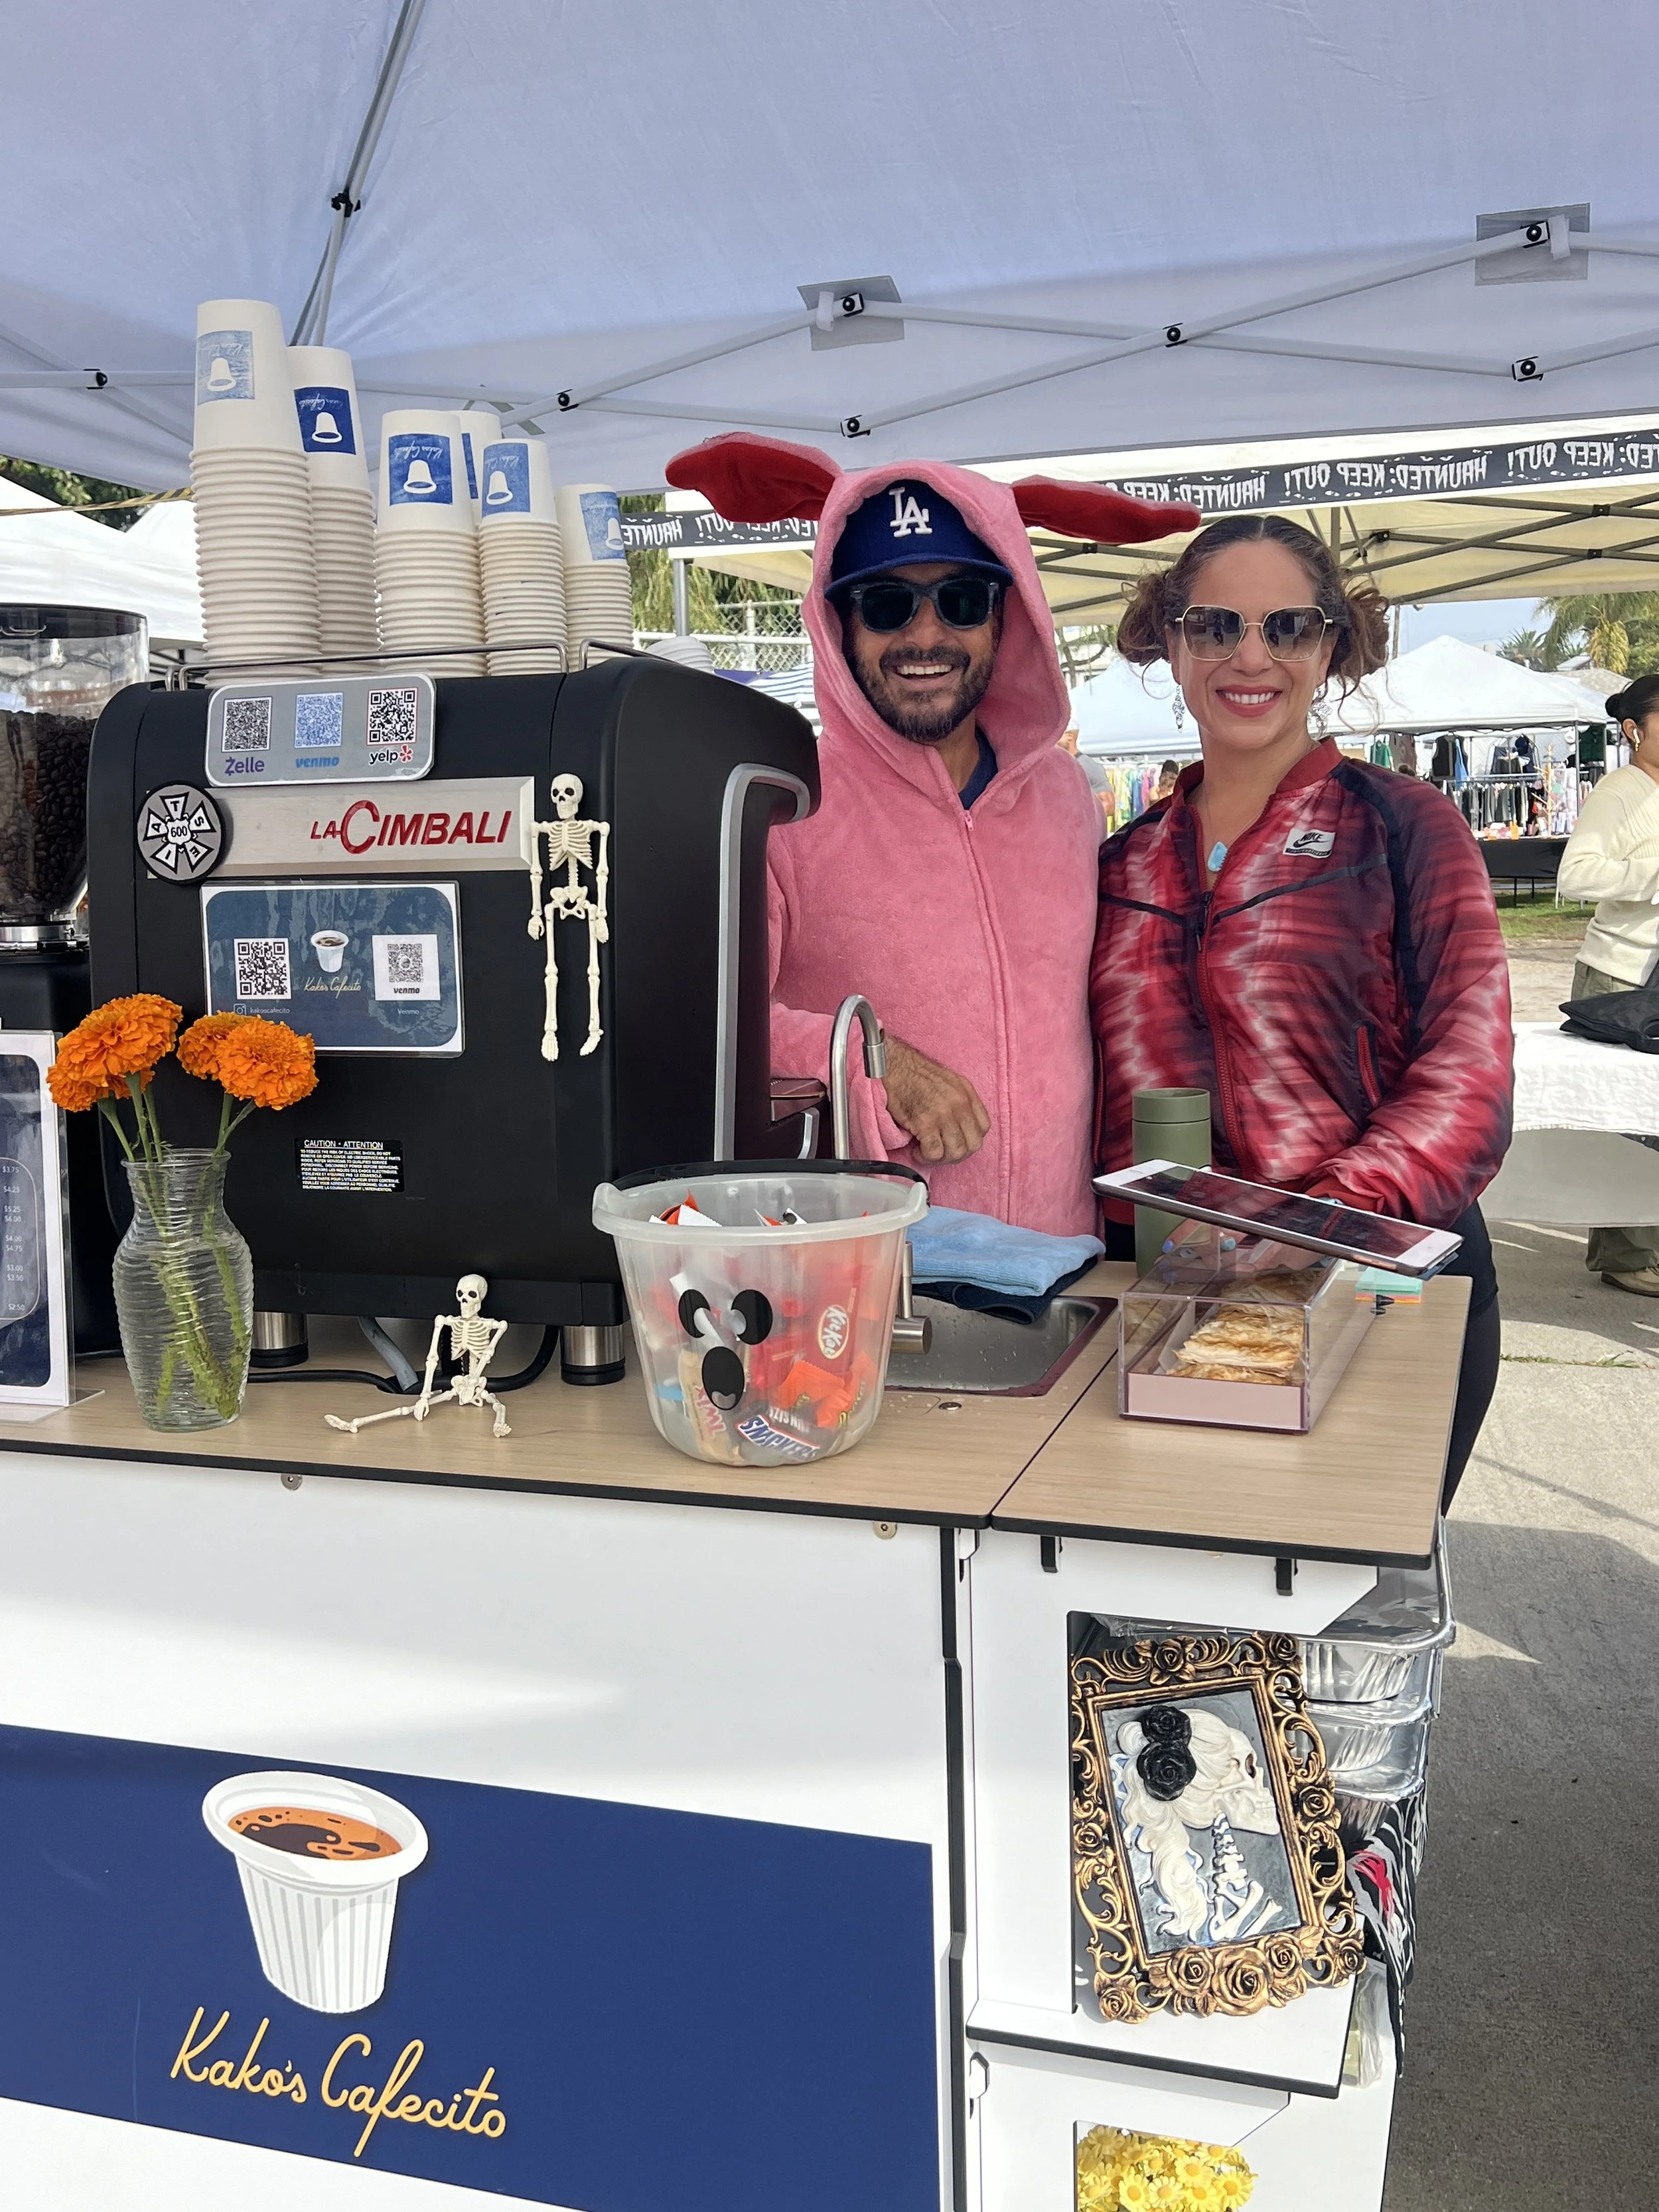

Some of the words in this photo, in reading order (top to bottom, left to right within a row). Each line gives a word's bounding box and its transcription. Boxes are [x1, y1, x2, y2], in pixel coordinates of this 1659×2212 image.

[889, 487, 934, 538] LA
[224, 756, 265, 776] Zelle
[295, 755, 340, 769] venmo
[369, 749, 398, 765] yelp
[171, 826, 187, 838] 600
[340, 800, 513, 855] CIMBALI
[1299, 832, 1325, 842] NIKE
[329, 975, 362, 999] Cafecito
[343, 1140, 384, 1149] ATTENTION
[171, 2006, 308, 2104] Kako's
[321, 2032, 507, 2159] Cafecito
